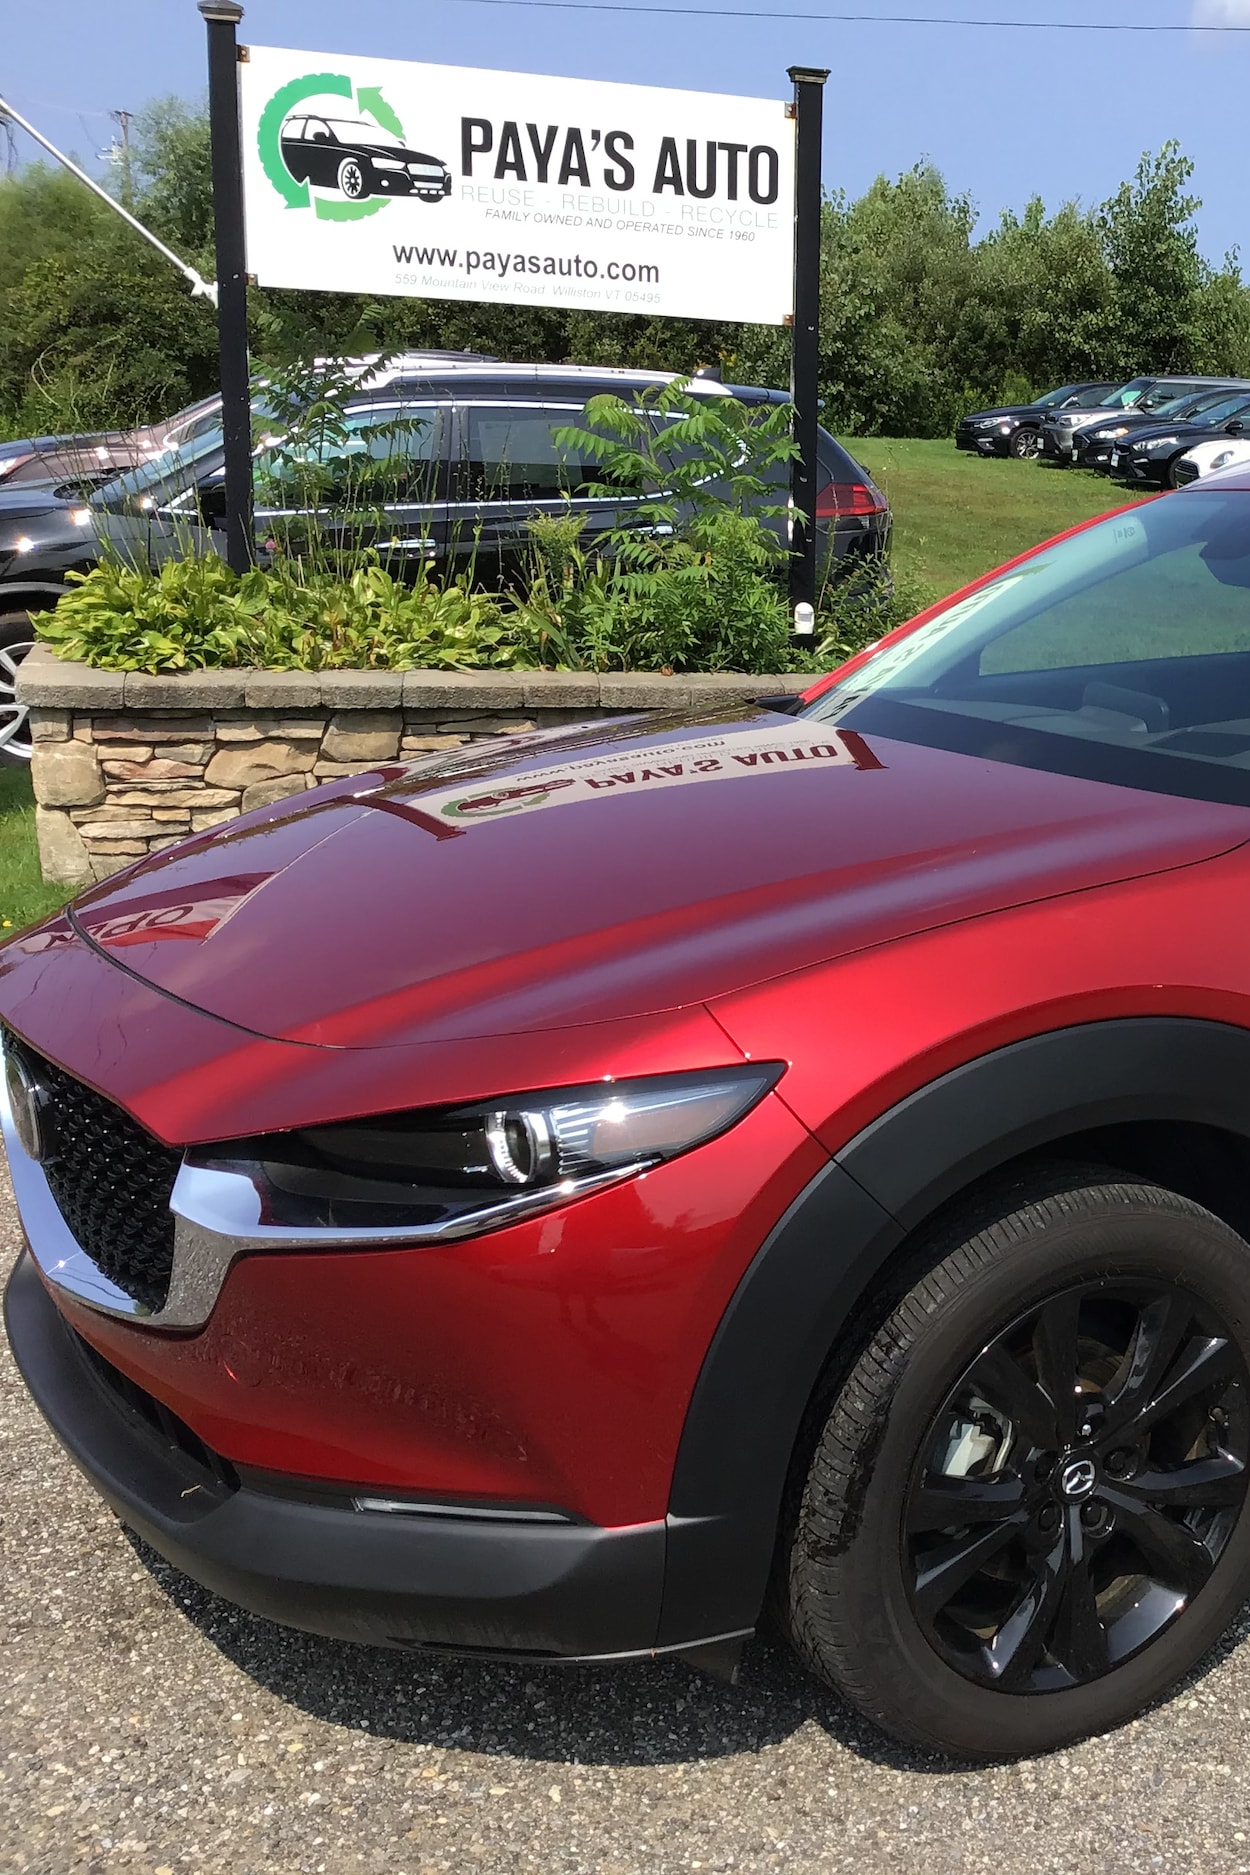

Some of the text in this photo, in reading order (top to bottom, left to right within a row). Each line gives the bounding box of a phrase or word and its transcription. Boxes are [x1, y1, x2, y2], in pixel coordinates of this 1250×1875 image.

[461, 116, 779, 205] PAYA'S AUTO
[461, 185, 535, 206] REUSE
[562, 194, 655, 217] REBUILD
[682, 205, 778, 229] RECYCLE
[485, 209, 755, 242] FAMILY OWNED AND OPERATED SINCE 1960
[392, 245, 660, 283] www.payasauto.com
[394, 274, 661, 304] 559 Mountain View Road Williston VT 05495
